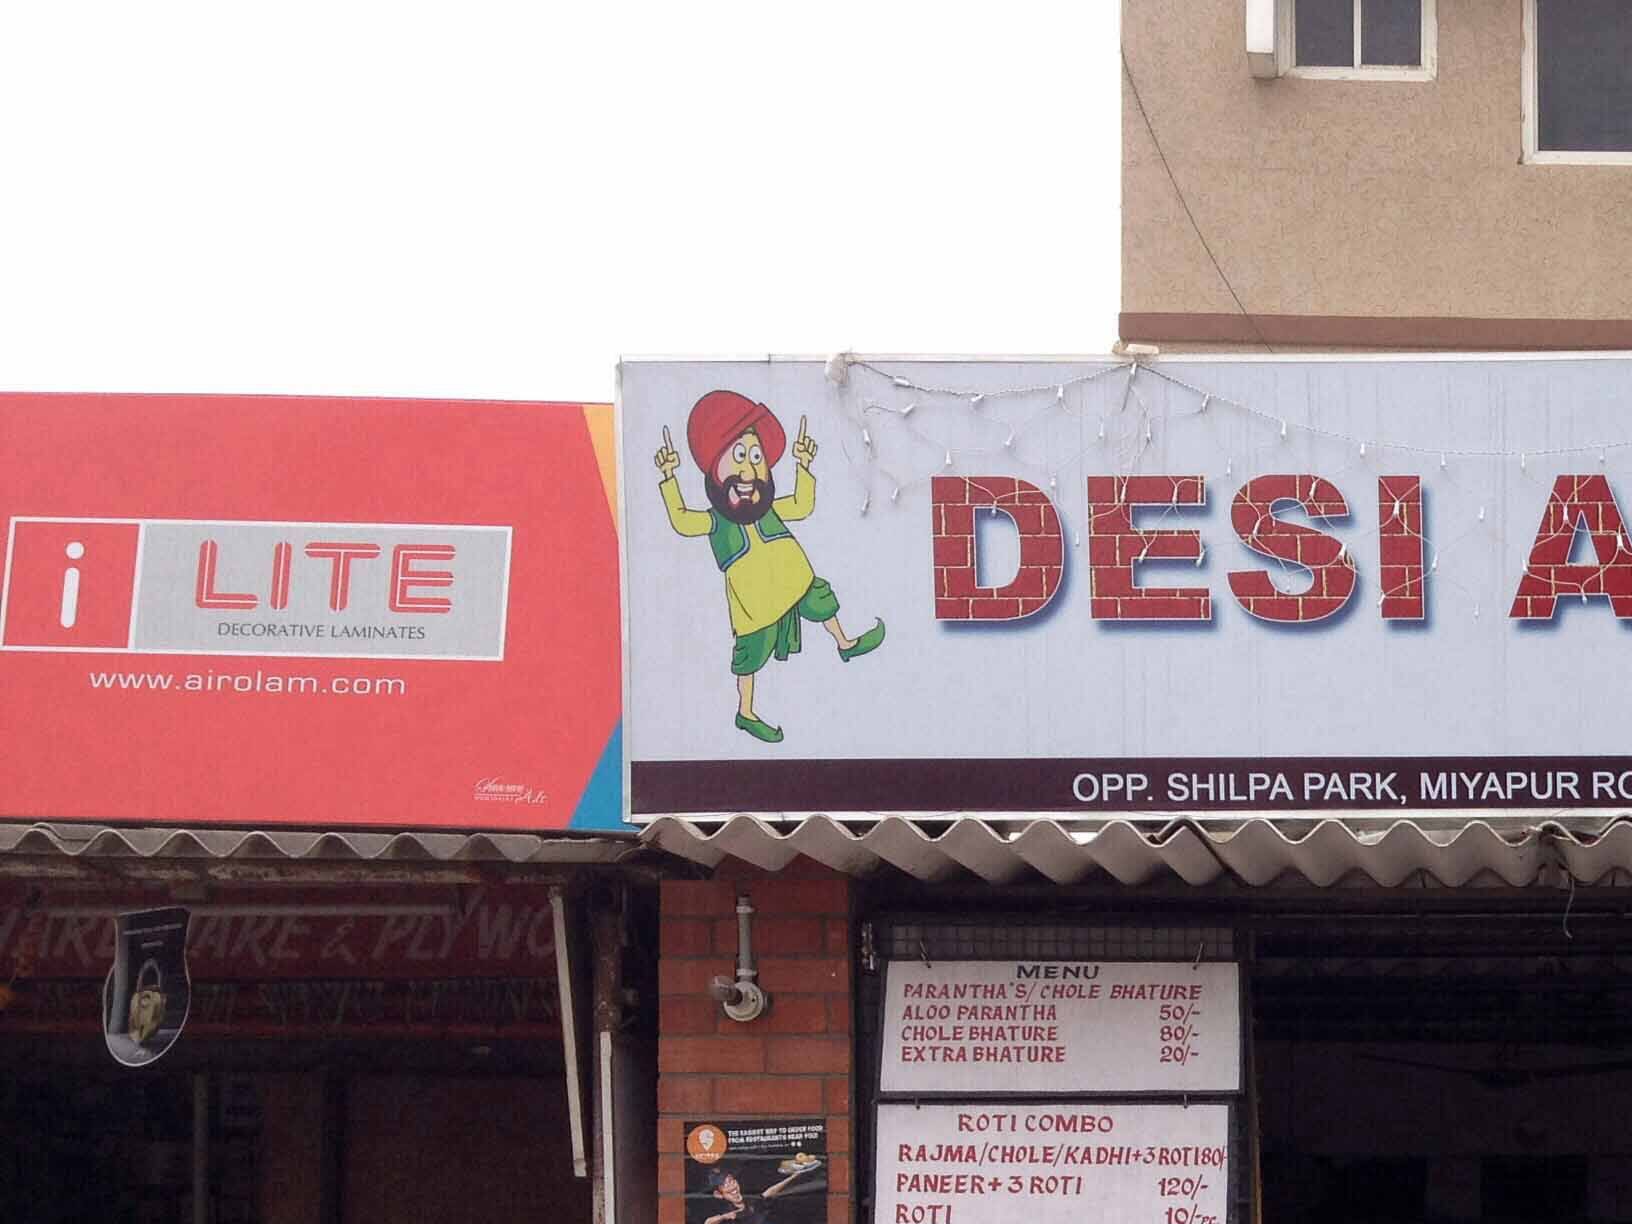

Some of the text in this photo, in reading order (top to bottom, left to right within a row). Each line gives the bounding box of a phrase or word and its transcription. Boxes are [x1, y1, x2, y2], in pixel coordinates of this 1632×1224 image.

[931, 474, 1424, 623] DESI
[194, 539, 457, 615] LITE
[217, 621, 425, 640] DECORATIVE LAMINATES
[89, 668, 406, 696] www.airolam.com
[1072, 772, 1153, 801] OPP.
[1168, 772, 1294, 801] SHILPA
[1303, 772, 1406, 805] PARK,
[1420, 772, 1579, 800] MIYAPUR
[1016, 965, 1101, 980] MENU
[1040, 984, 1101, 999] CHOLE
[1110, 984, 1202, 1000] BHATURE
[903, 1004, 1201, 1023] ALOO PARANTHA 50/-
[901, 1025, 1199, 1045] CHOLE BHATURE 80/-
[901, 1046, 1199, 1066] EXTRA BHATURE 20/-
[958, 1114, 1114, 1132] ROTI COMBO
[1030, 1176, 1082, 1194] ROTI
[1158, 1174, 1208, 1201] 120/-
[895, 1204, 952, 1224] ROTI
